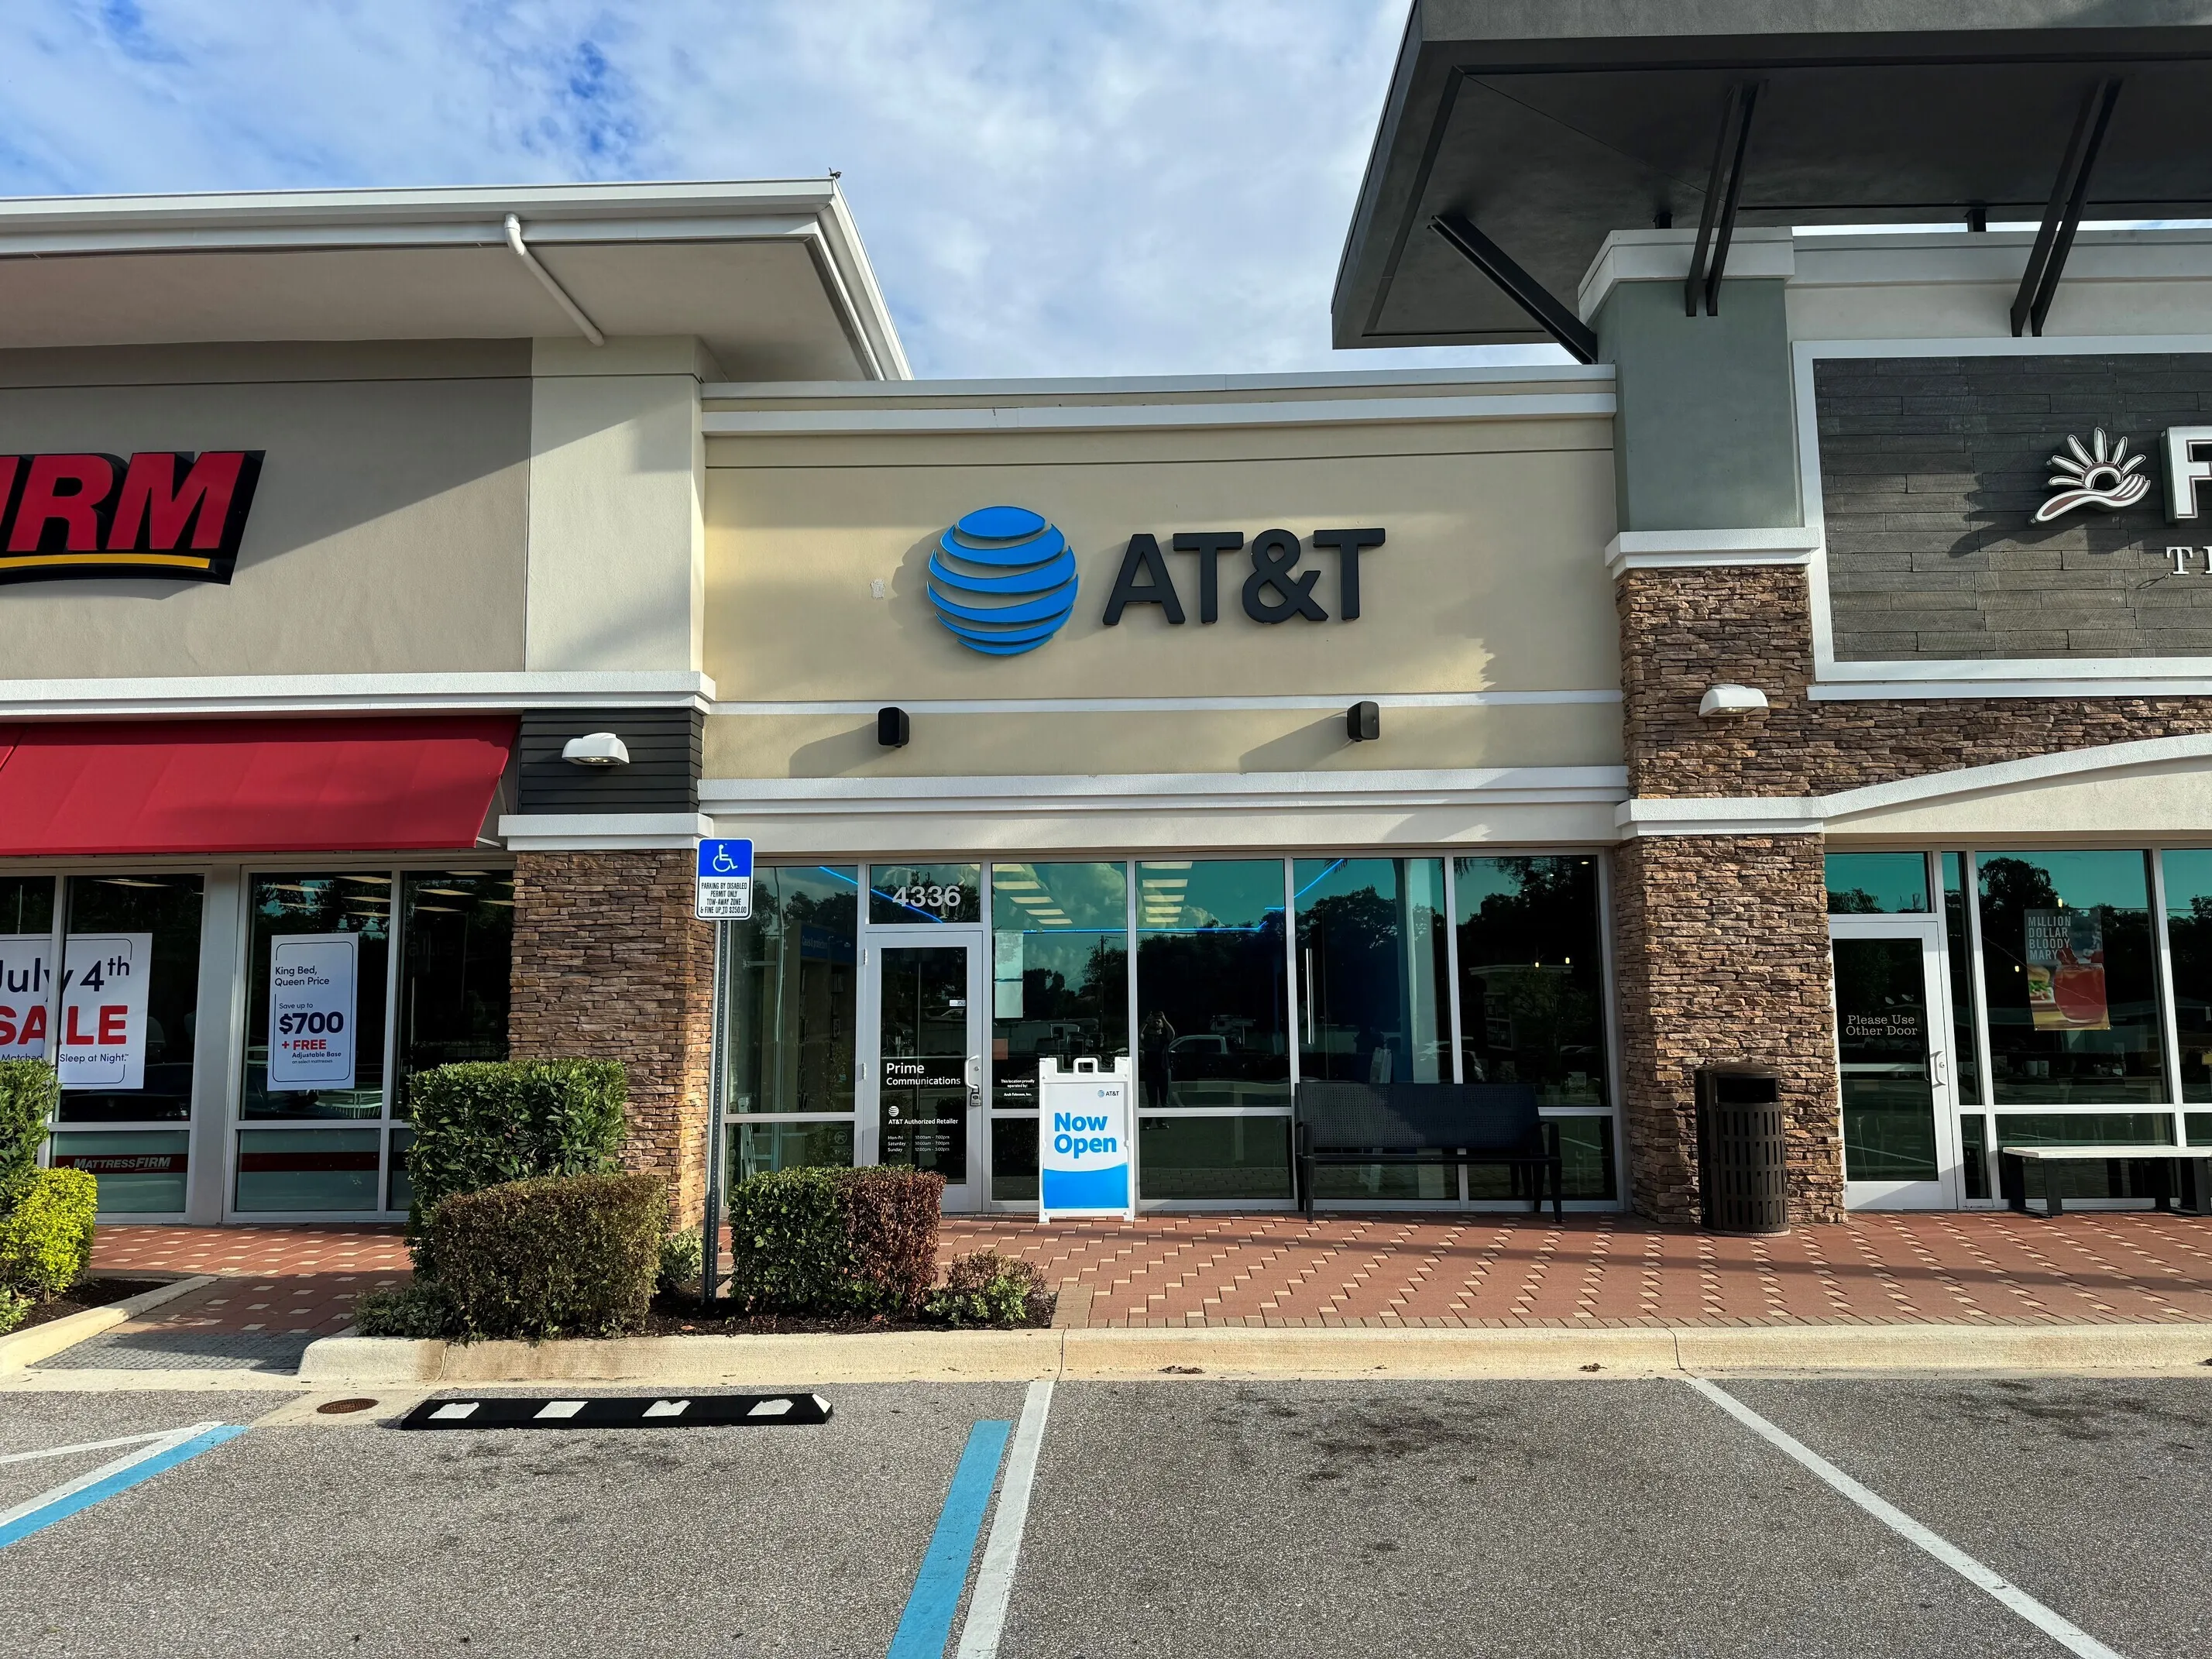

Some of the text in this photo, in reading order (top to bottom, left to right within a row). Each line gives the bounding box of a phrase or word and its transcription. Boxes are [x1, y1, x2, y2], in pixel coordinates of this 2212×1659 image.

[0, 452, 245, 551] RM
[1102, 527, 1386, 626] AT&T
[892, 885, 961, 907] 4336
[2028, 915, 2071, 927] MILLION
[2028, 927, 2068, 938] DOLLAR
[2029, 938, 2070, 949] BLOODY
[2029, 950, 2058, 960] MARY
[79, 956, 130, 992] 4th
[275, 965, 318, 977] King Bed,
[274, 977, 330, 987] Queen Price
[279, 1011, 344, 1035] $700
[1847, 1015, 1915, 1025] Please Use
[1846, 1025, 1918, 1036] Other Door
[293, 1039, 327, 1051] FREE
[60, 1053, 86, 1063] Sleep
[88, 1053, 97, 1062] at
[886, 1062, 925, 1074] Prime
[886, 1076, 961, 1085] Communications
[1054, 1112, 1108, 1132] Now
[1054, 1134, 1117, 1159] Open
